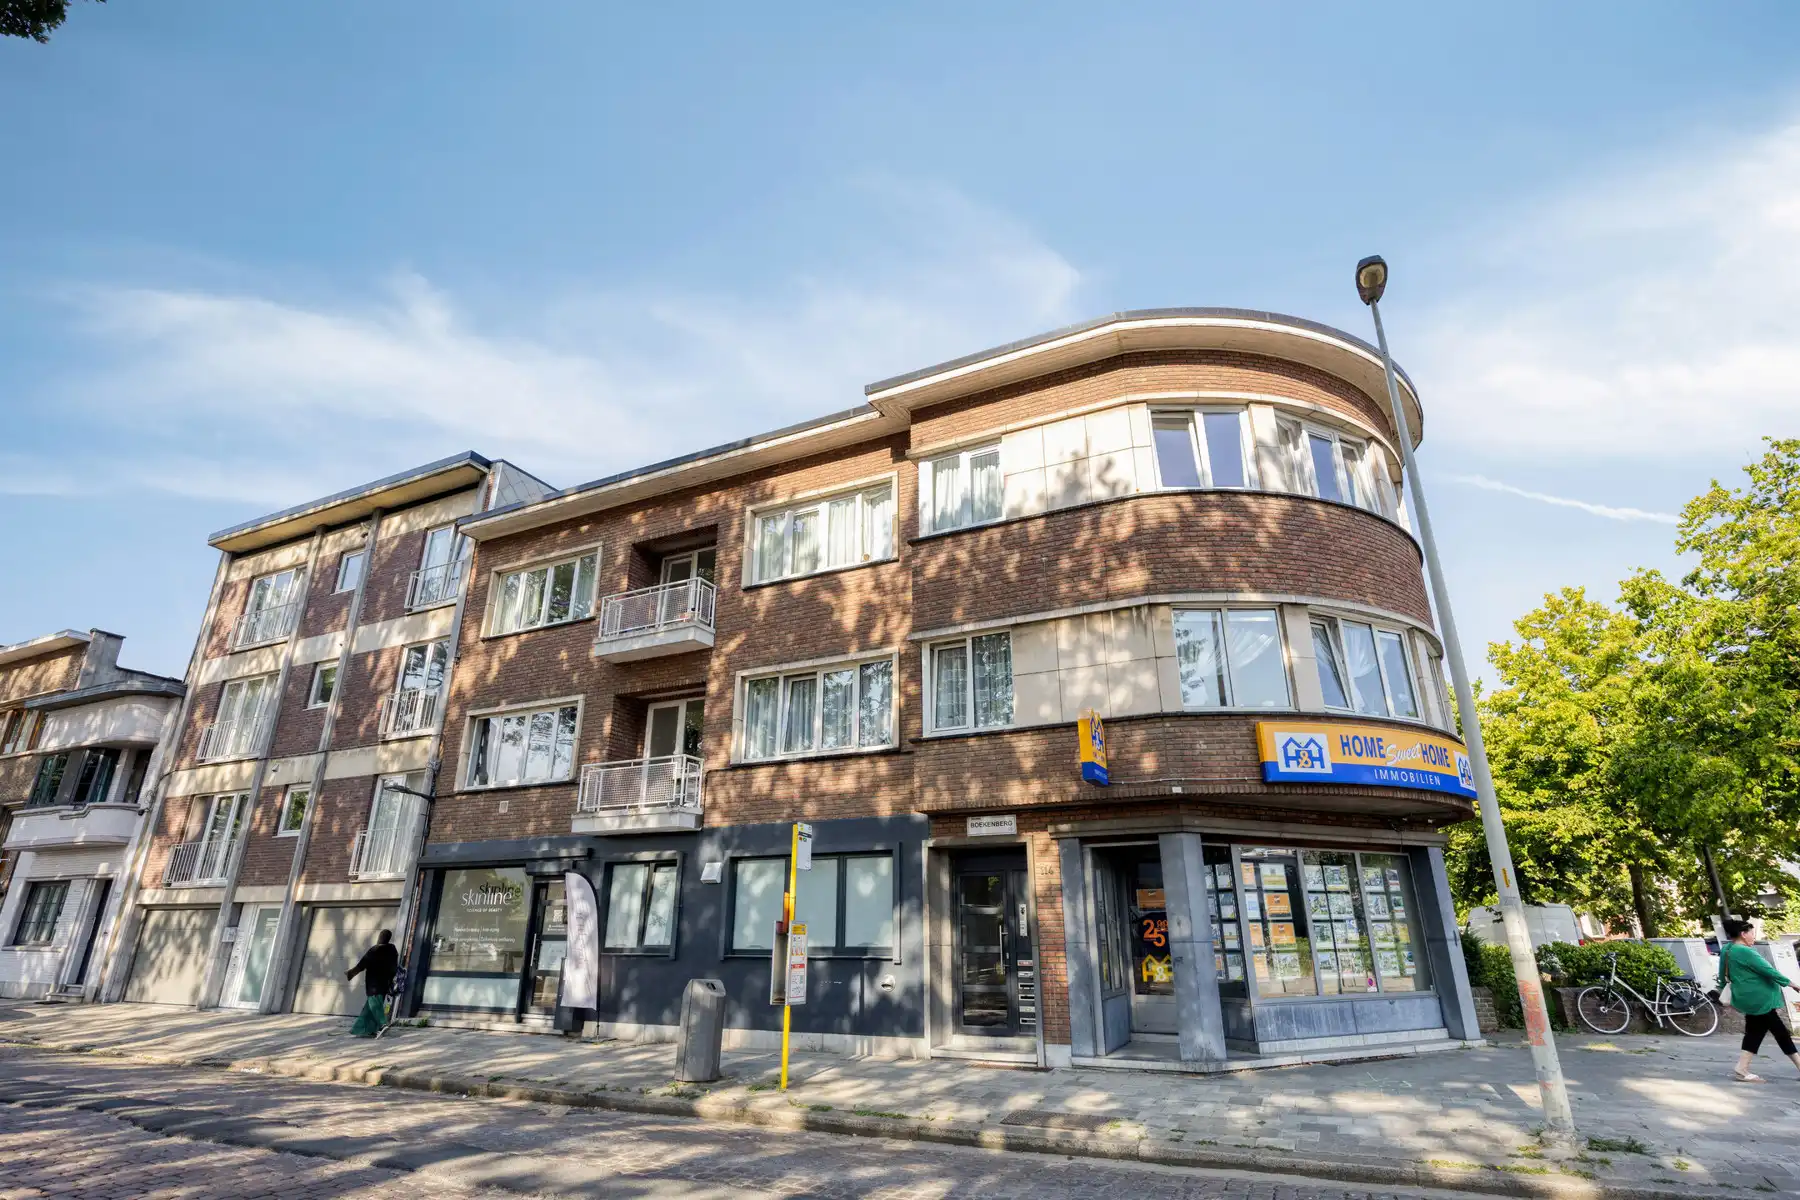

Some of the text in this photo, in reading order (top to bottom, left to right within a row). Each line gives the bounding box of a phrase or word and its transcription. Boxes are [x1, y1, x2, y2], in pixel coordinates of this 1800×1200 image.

[1339, 734, 1451, 768] HOME Sweet HOME
[1374, 768, 1441, 786] IMMOBILIEN
[970, 820, 1013, 829] BOEKENBERG
[460, 888, 512, 907] skinline
